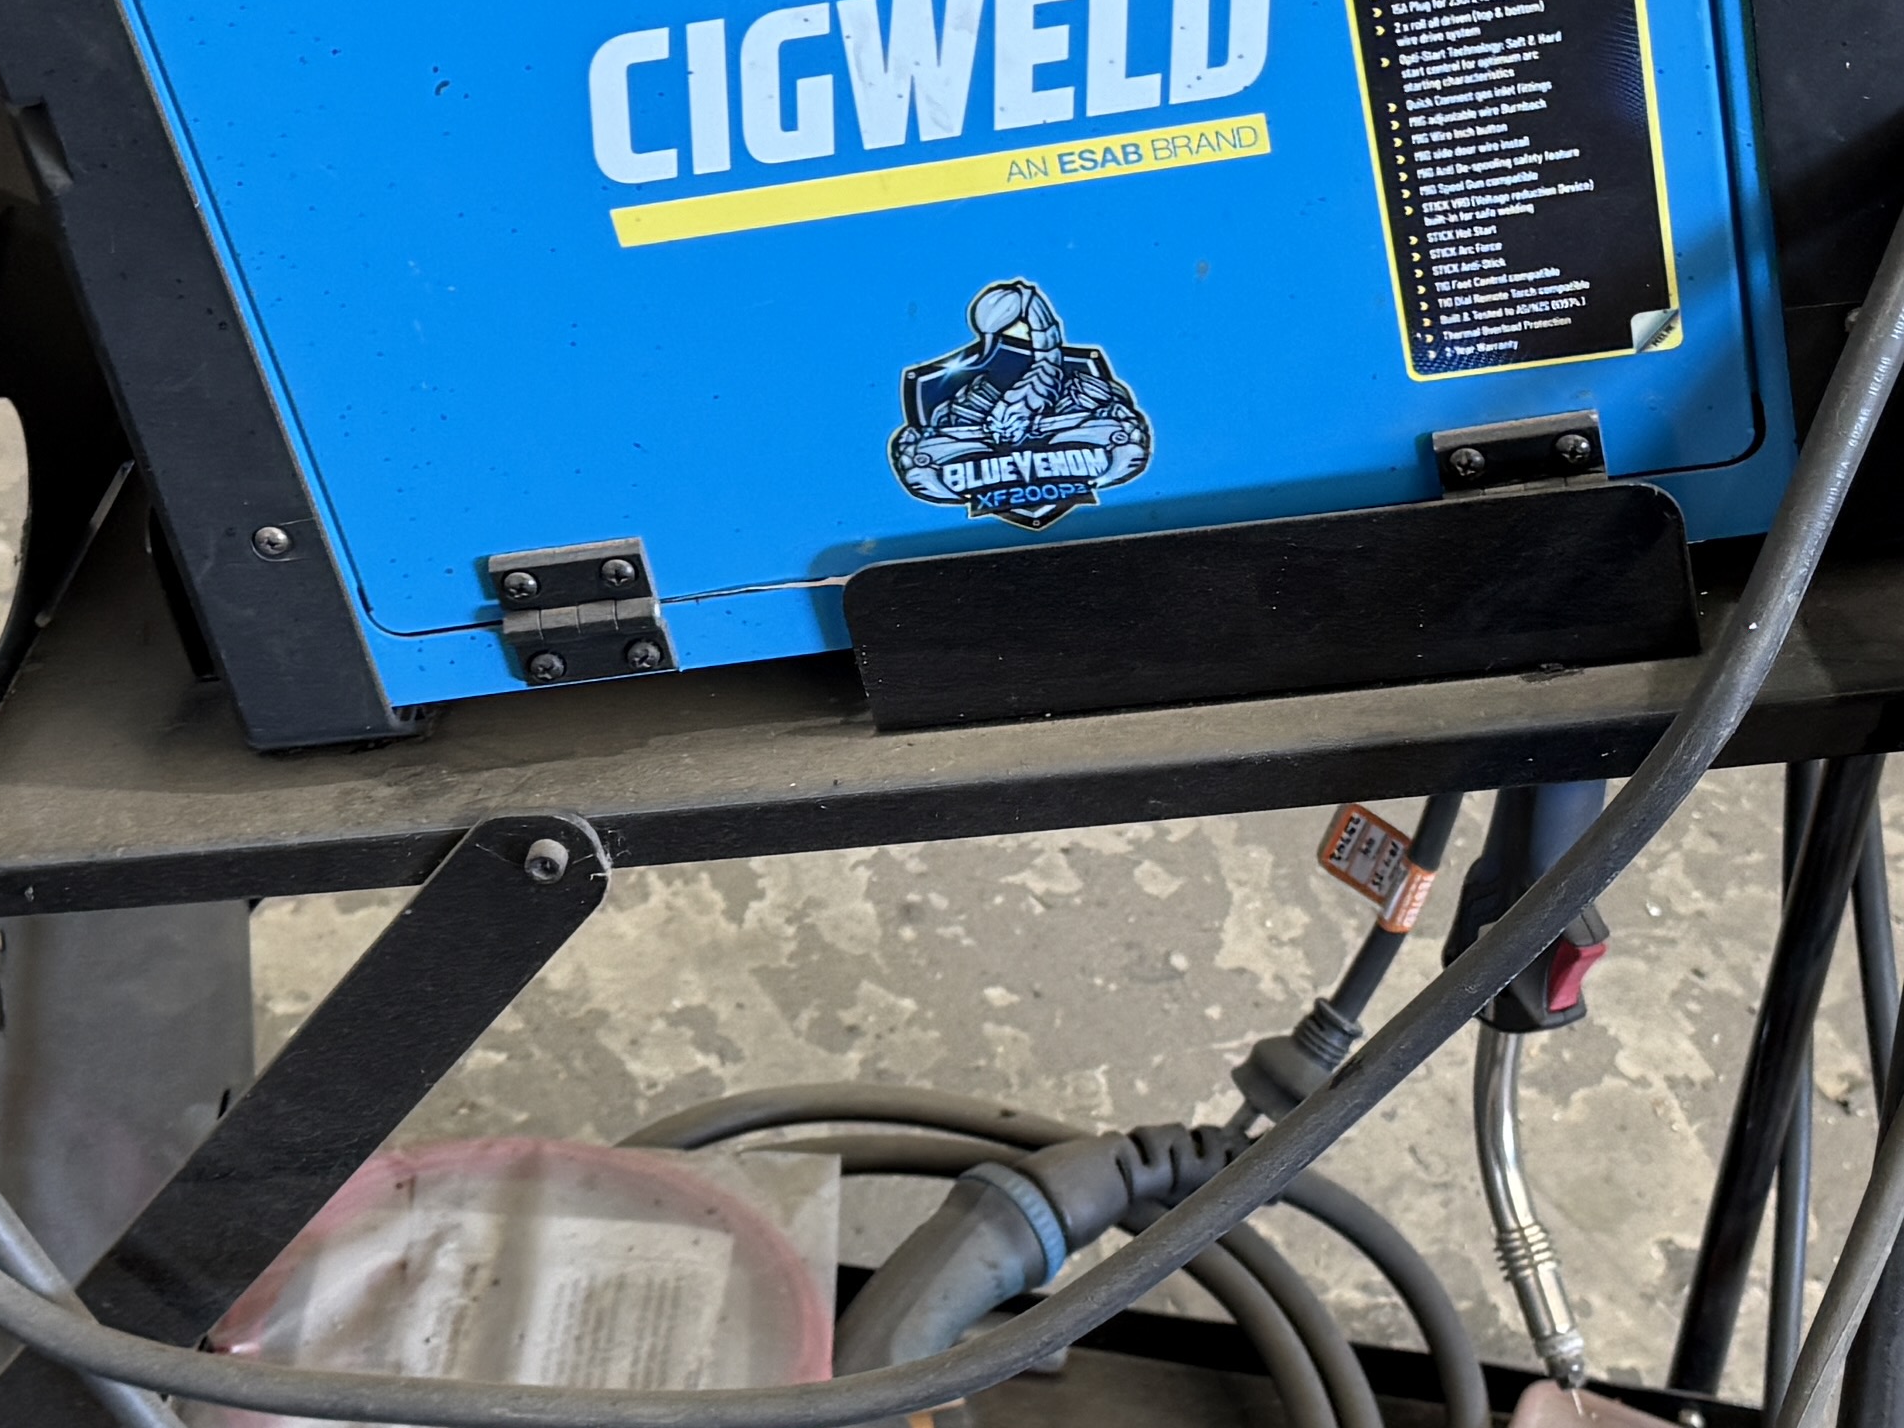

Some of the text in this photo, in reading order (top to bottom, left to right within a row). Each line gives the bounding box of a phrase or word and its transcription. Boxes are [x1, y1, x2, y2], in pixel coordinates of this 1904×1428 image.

[1006, 125, 1258, 183] AN ESAB BRAND
